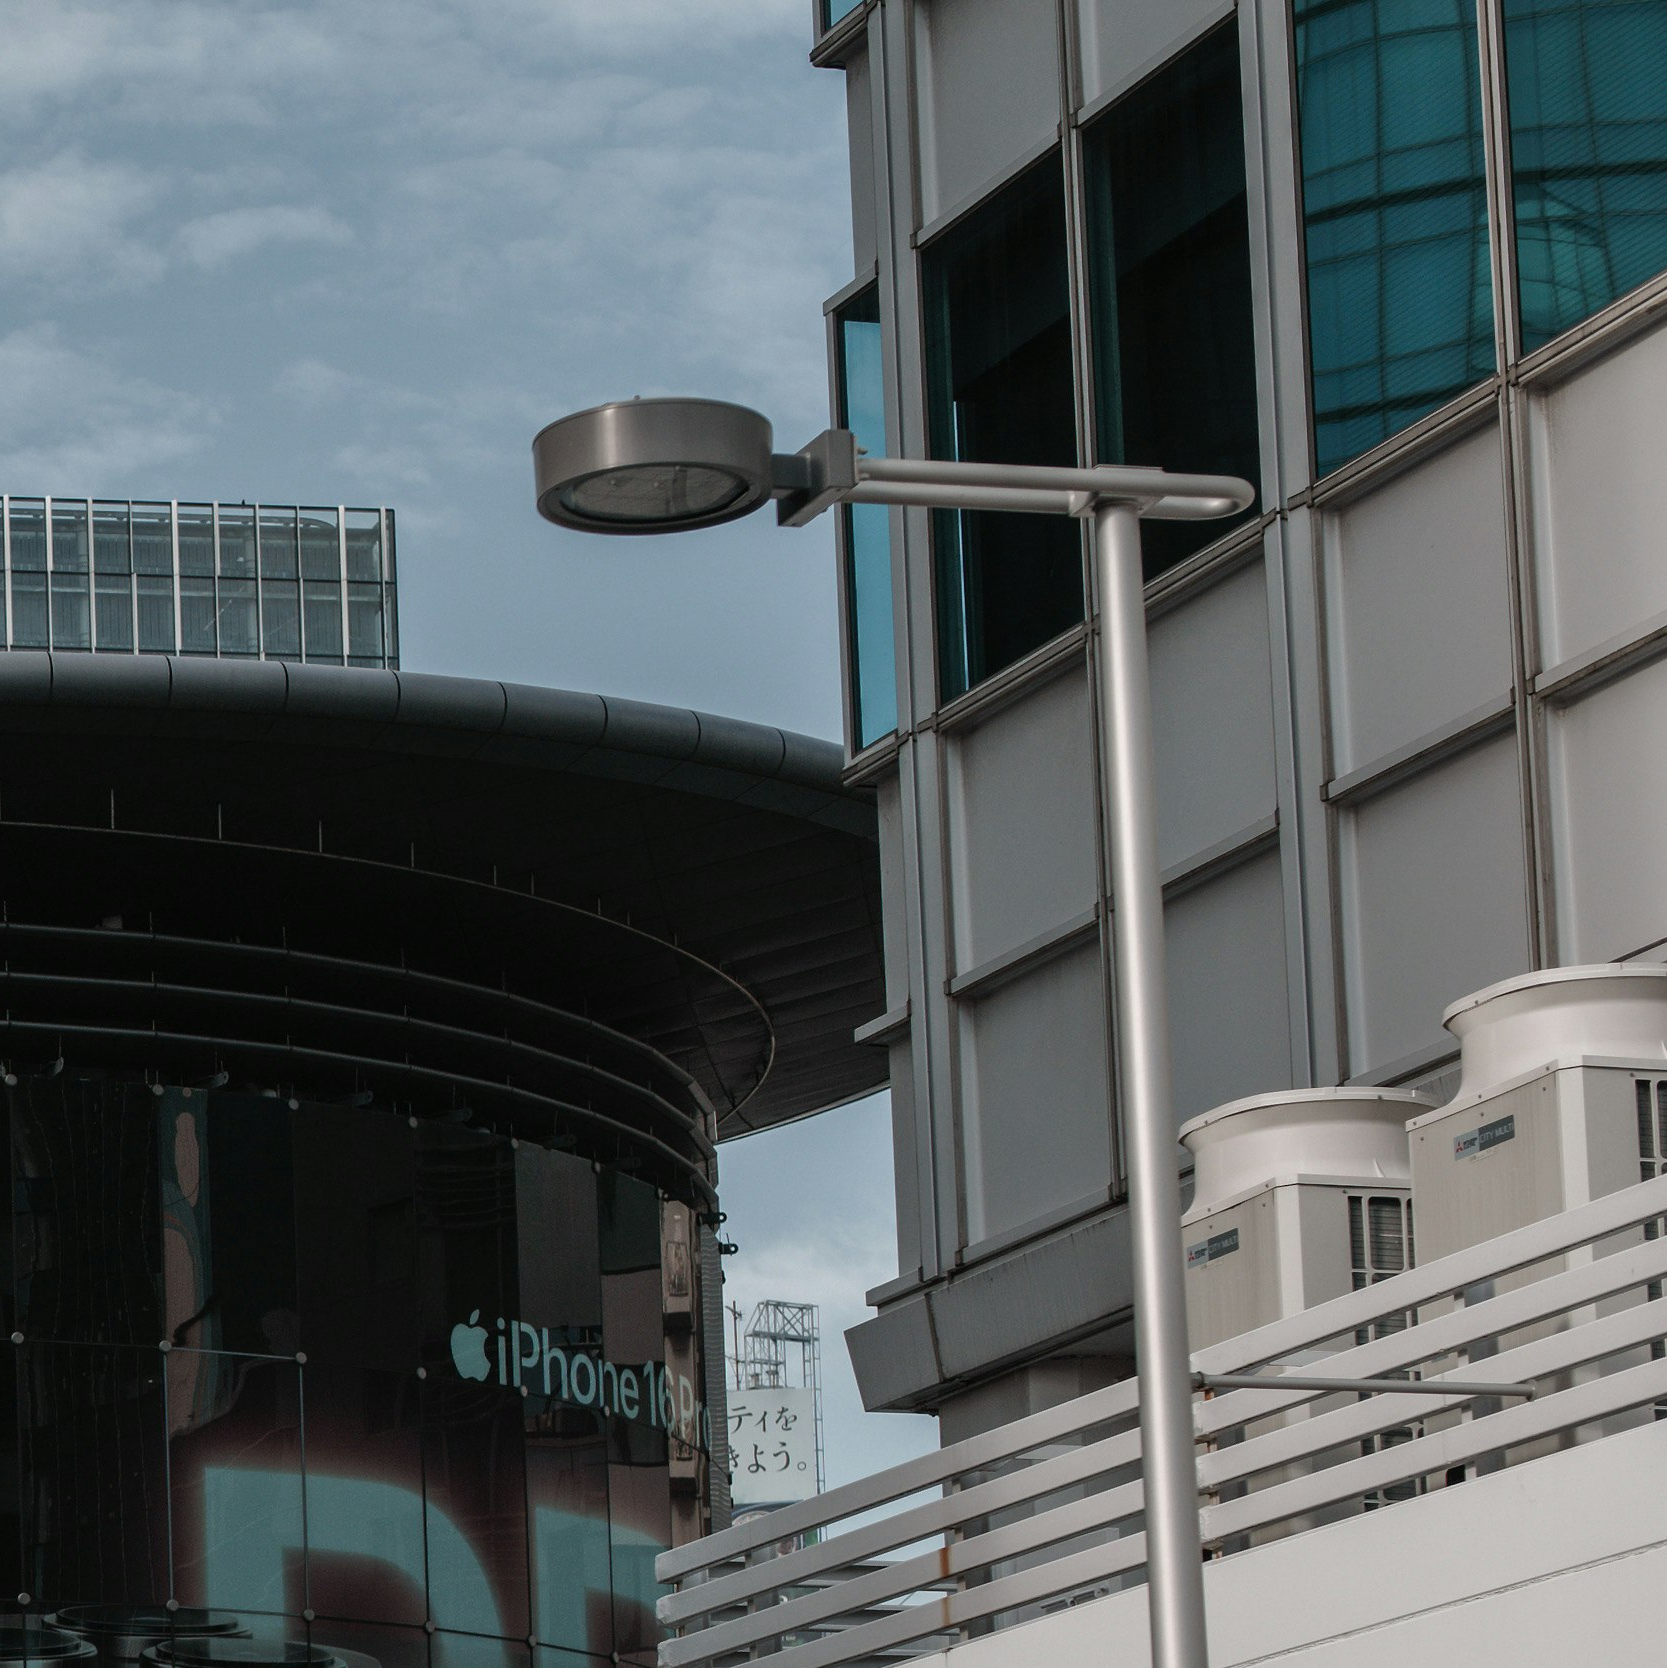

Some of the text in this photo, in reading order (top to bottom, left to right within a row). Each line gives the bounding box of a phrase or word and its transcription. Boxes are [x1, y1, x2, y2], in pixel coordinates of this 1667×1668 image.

[496, 1316, 639, 1421] iPhone
[643, 1360, 676, 1434] 16
[727, 1405, 798, 1434] ティを
